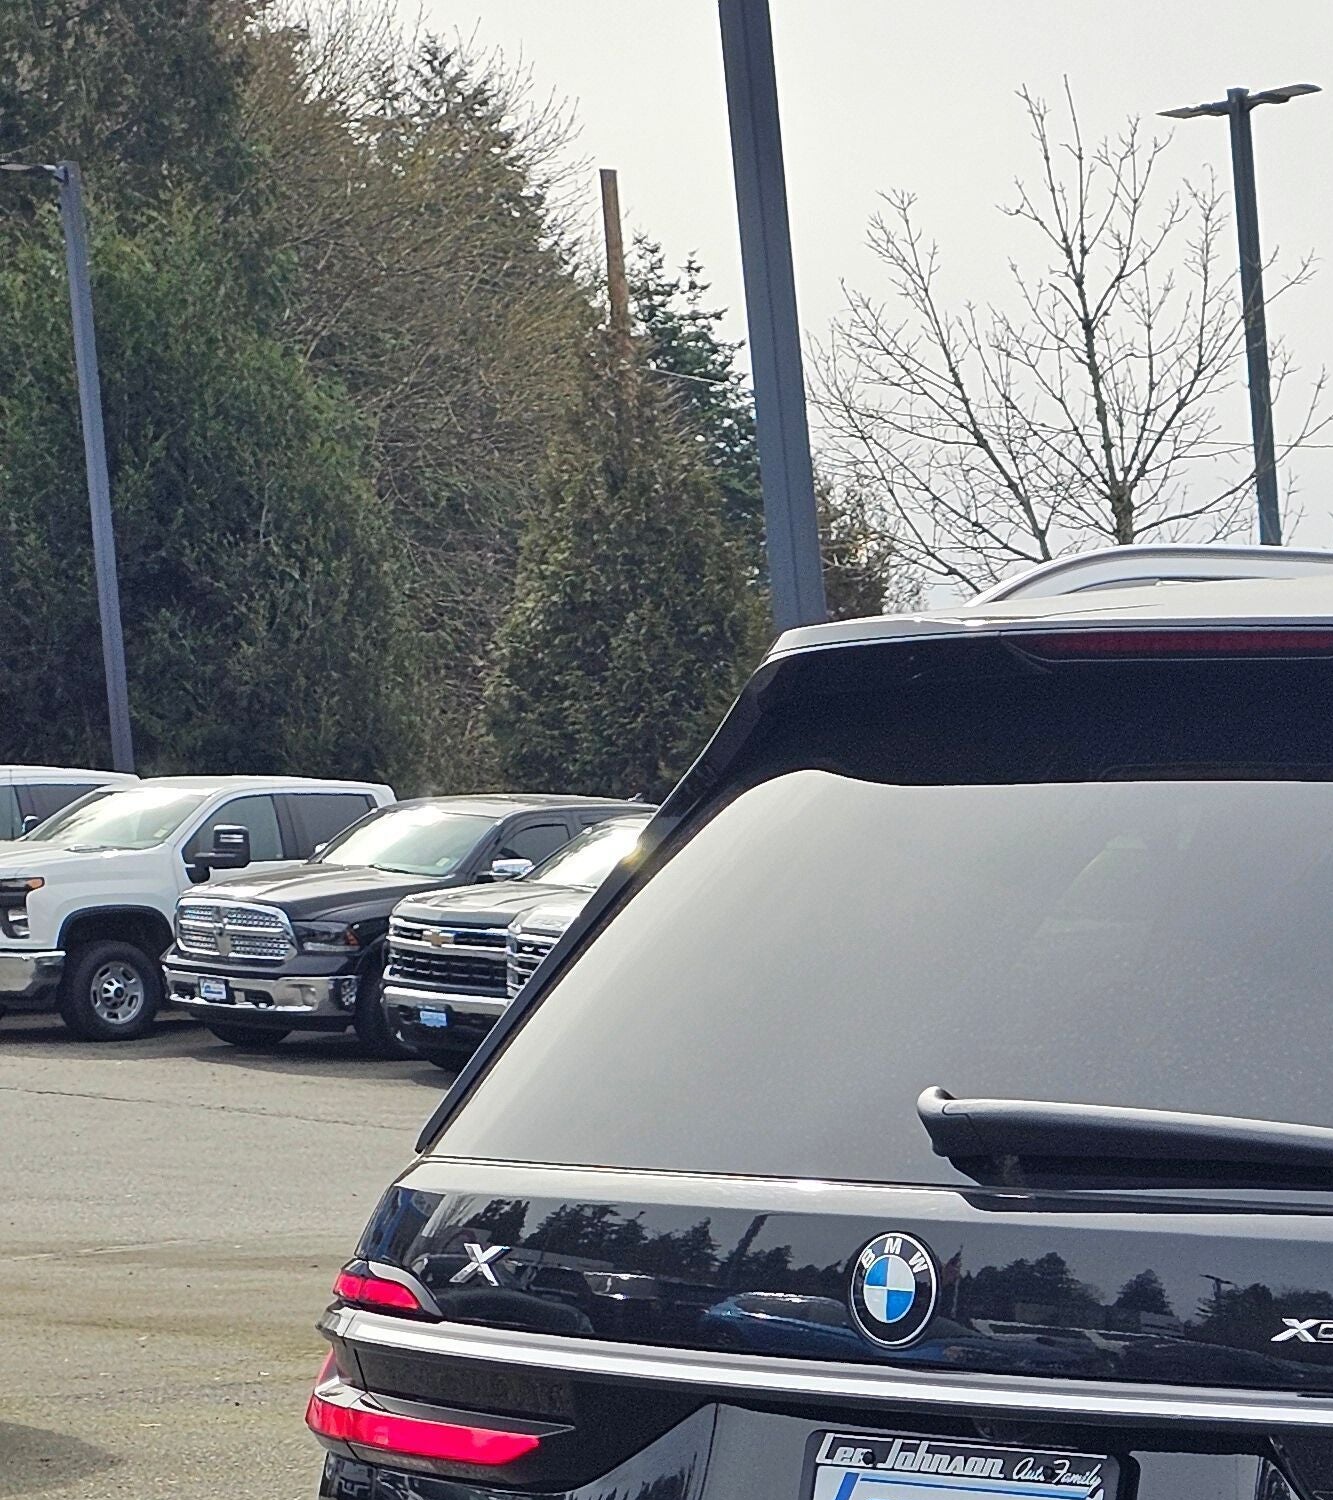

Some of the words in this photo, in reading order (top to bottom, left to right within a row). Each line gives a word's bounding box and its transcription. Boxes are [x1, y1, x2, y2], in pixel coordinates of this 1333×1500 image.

[449, 1242, 511, 1287] X
[861, 1237, 929, 1274] BMW
[816, 1432, 874, 1468] Lee
[875, 1438, 1004, 1480] Johnson
[1051, 1459, 1102, 1496] Family
